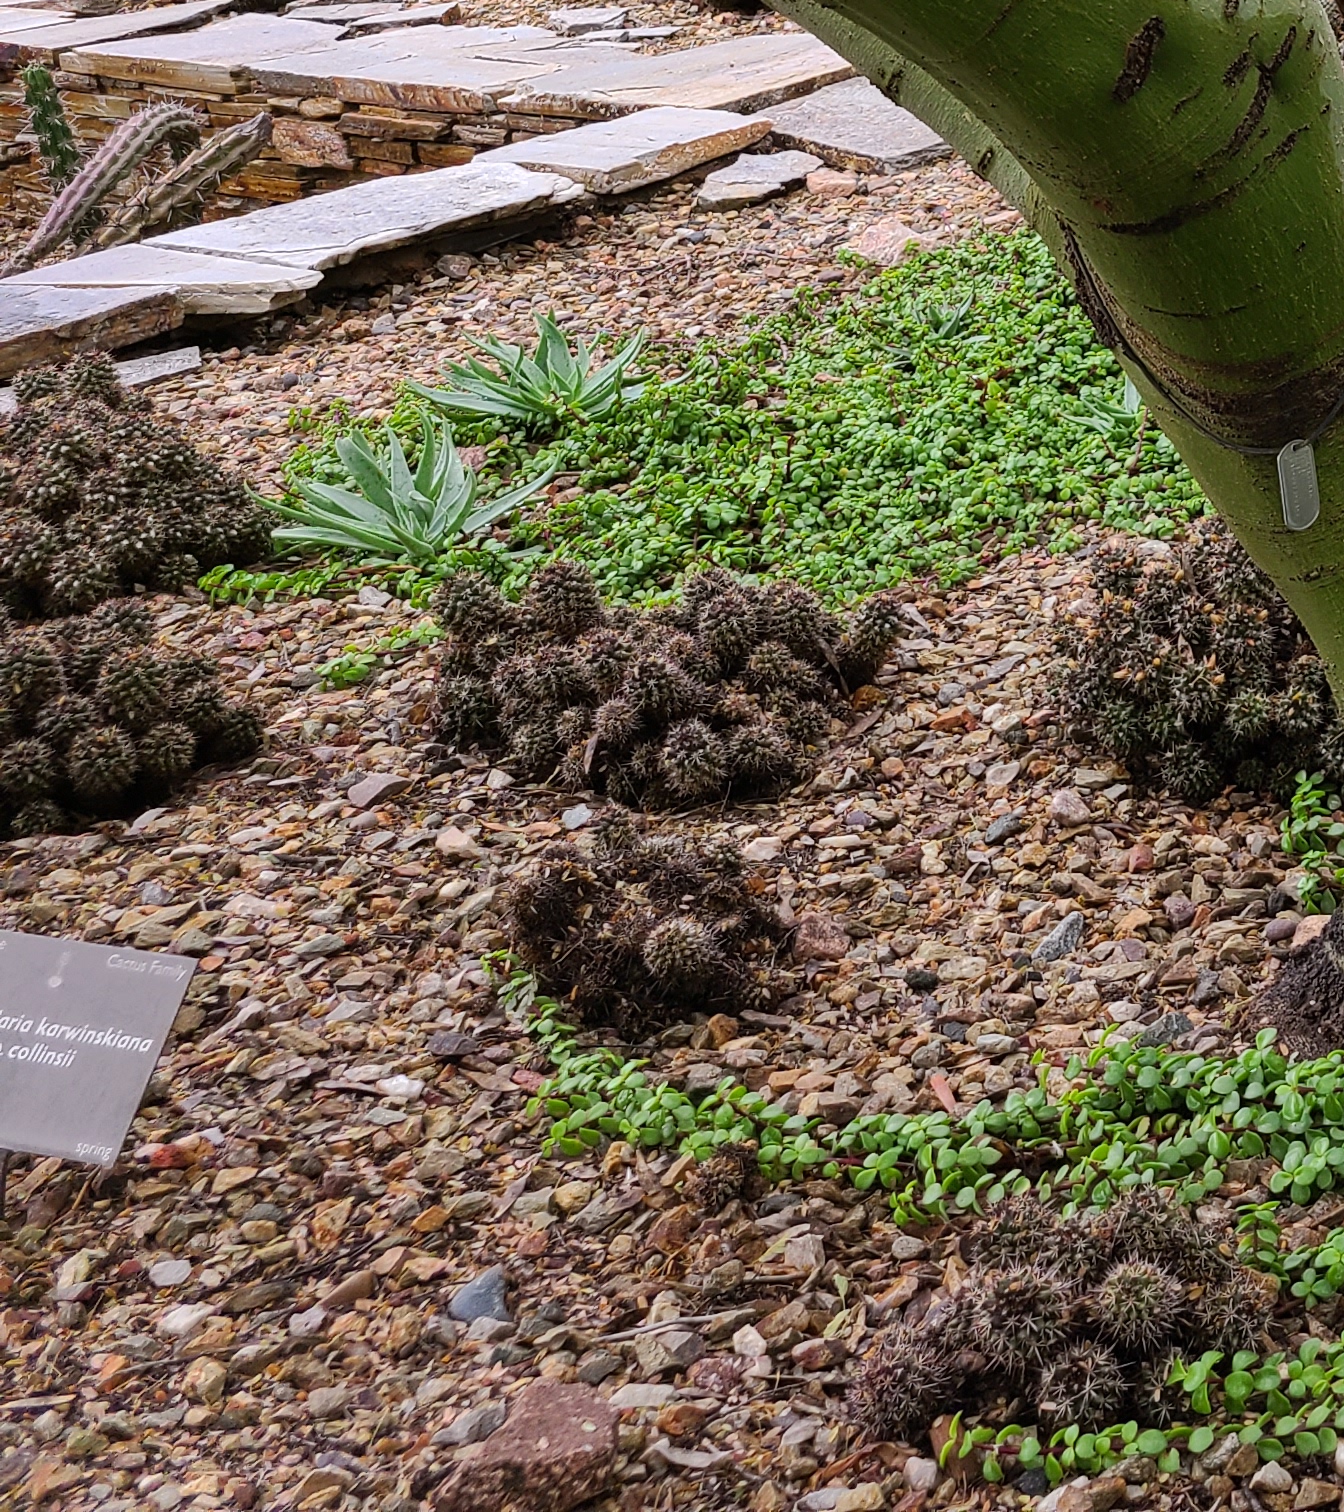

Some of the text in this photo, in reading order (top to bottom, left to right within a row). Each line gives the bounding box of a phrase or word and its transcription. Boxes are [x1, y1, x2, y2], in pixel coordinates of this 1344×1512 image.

[107, 954, 188, 982] Cactus Family
[35, 1017, 154, 1053] karwinskiana
[8, 1042, 78, 1068] collinsii
[75, 1142, 113, 1161] spring
